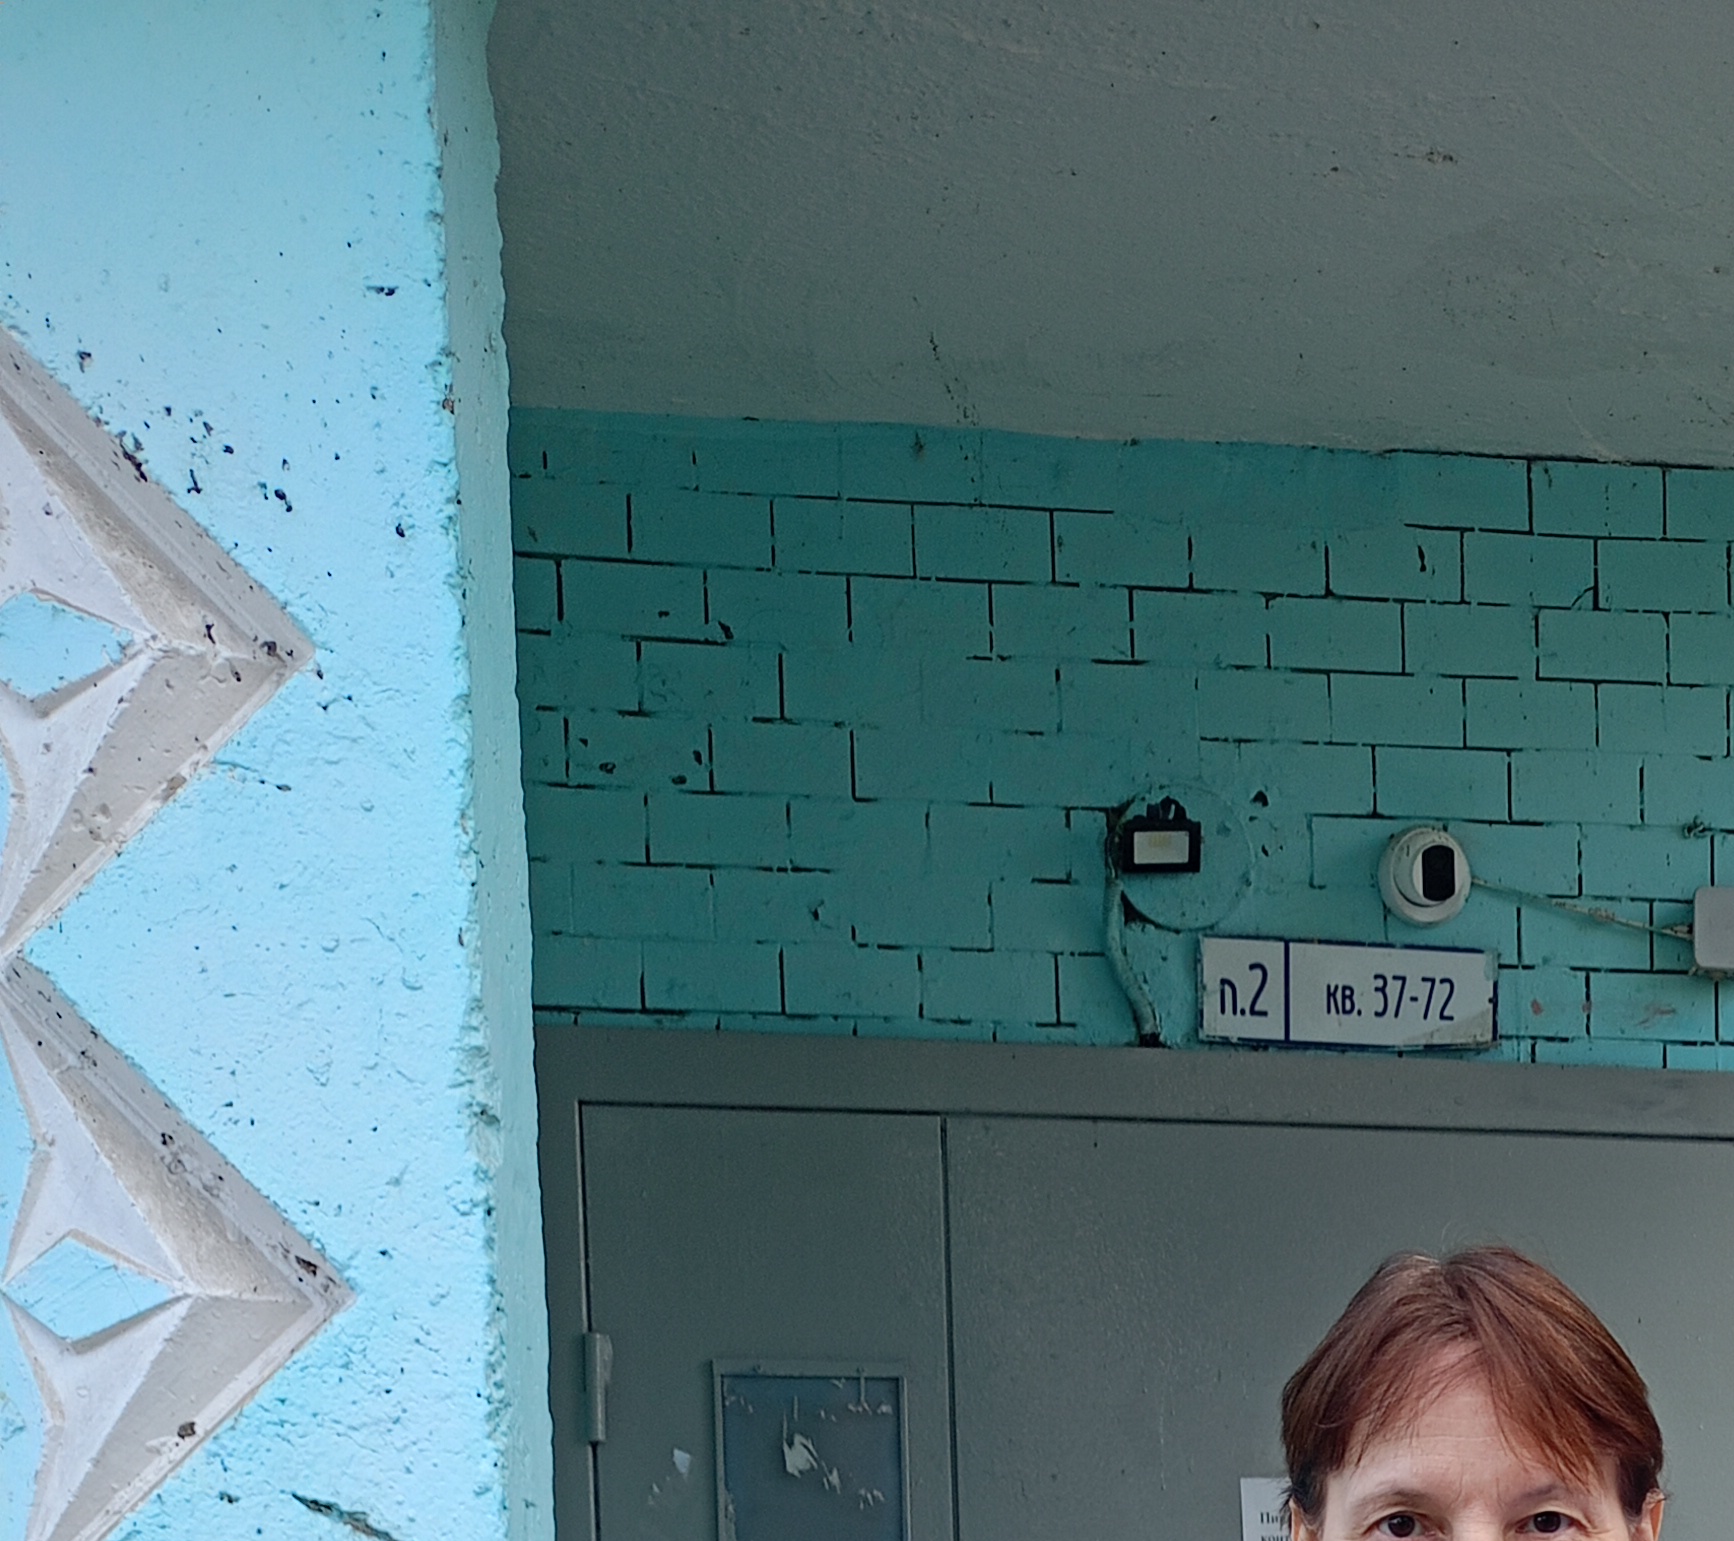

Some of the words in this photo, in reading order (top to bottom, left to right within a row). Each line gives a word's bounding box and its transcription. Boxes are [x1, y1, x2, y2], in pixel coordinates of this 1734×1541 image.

[1219, 962, 1270, 1017] п.2
[1326, 982, 1362, 1017] кв.
[1372, 973, 1455, 1022] 37-72
